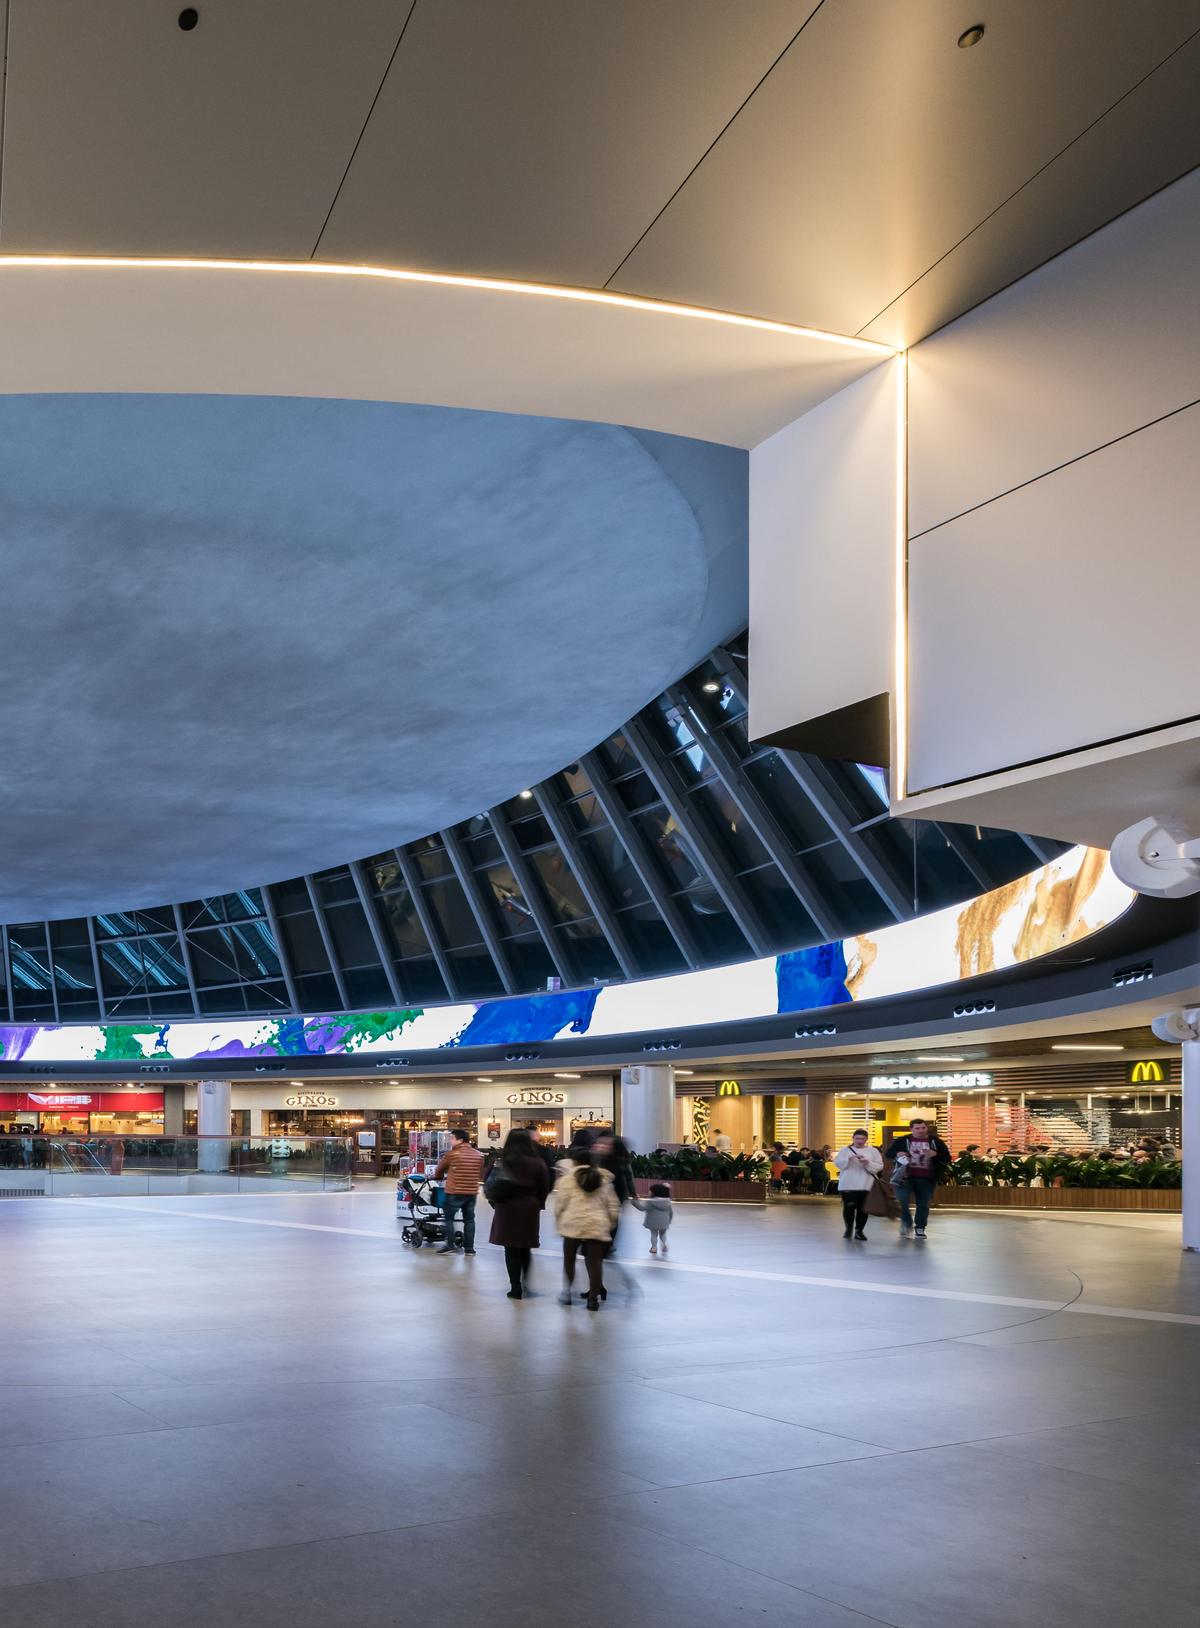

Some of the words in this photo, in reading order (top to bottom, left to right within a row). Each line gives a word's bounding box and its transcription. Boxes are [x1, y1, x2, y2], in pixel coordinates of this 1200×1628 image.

[871, 1073, 991, 1089] McDonald's
[286, 1096, 336, 1105] GINOS
[506, 1092, 564, 1103] GINOS
